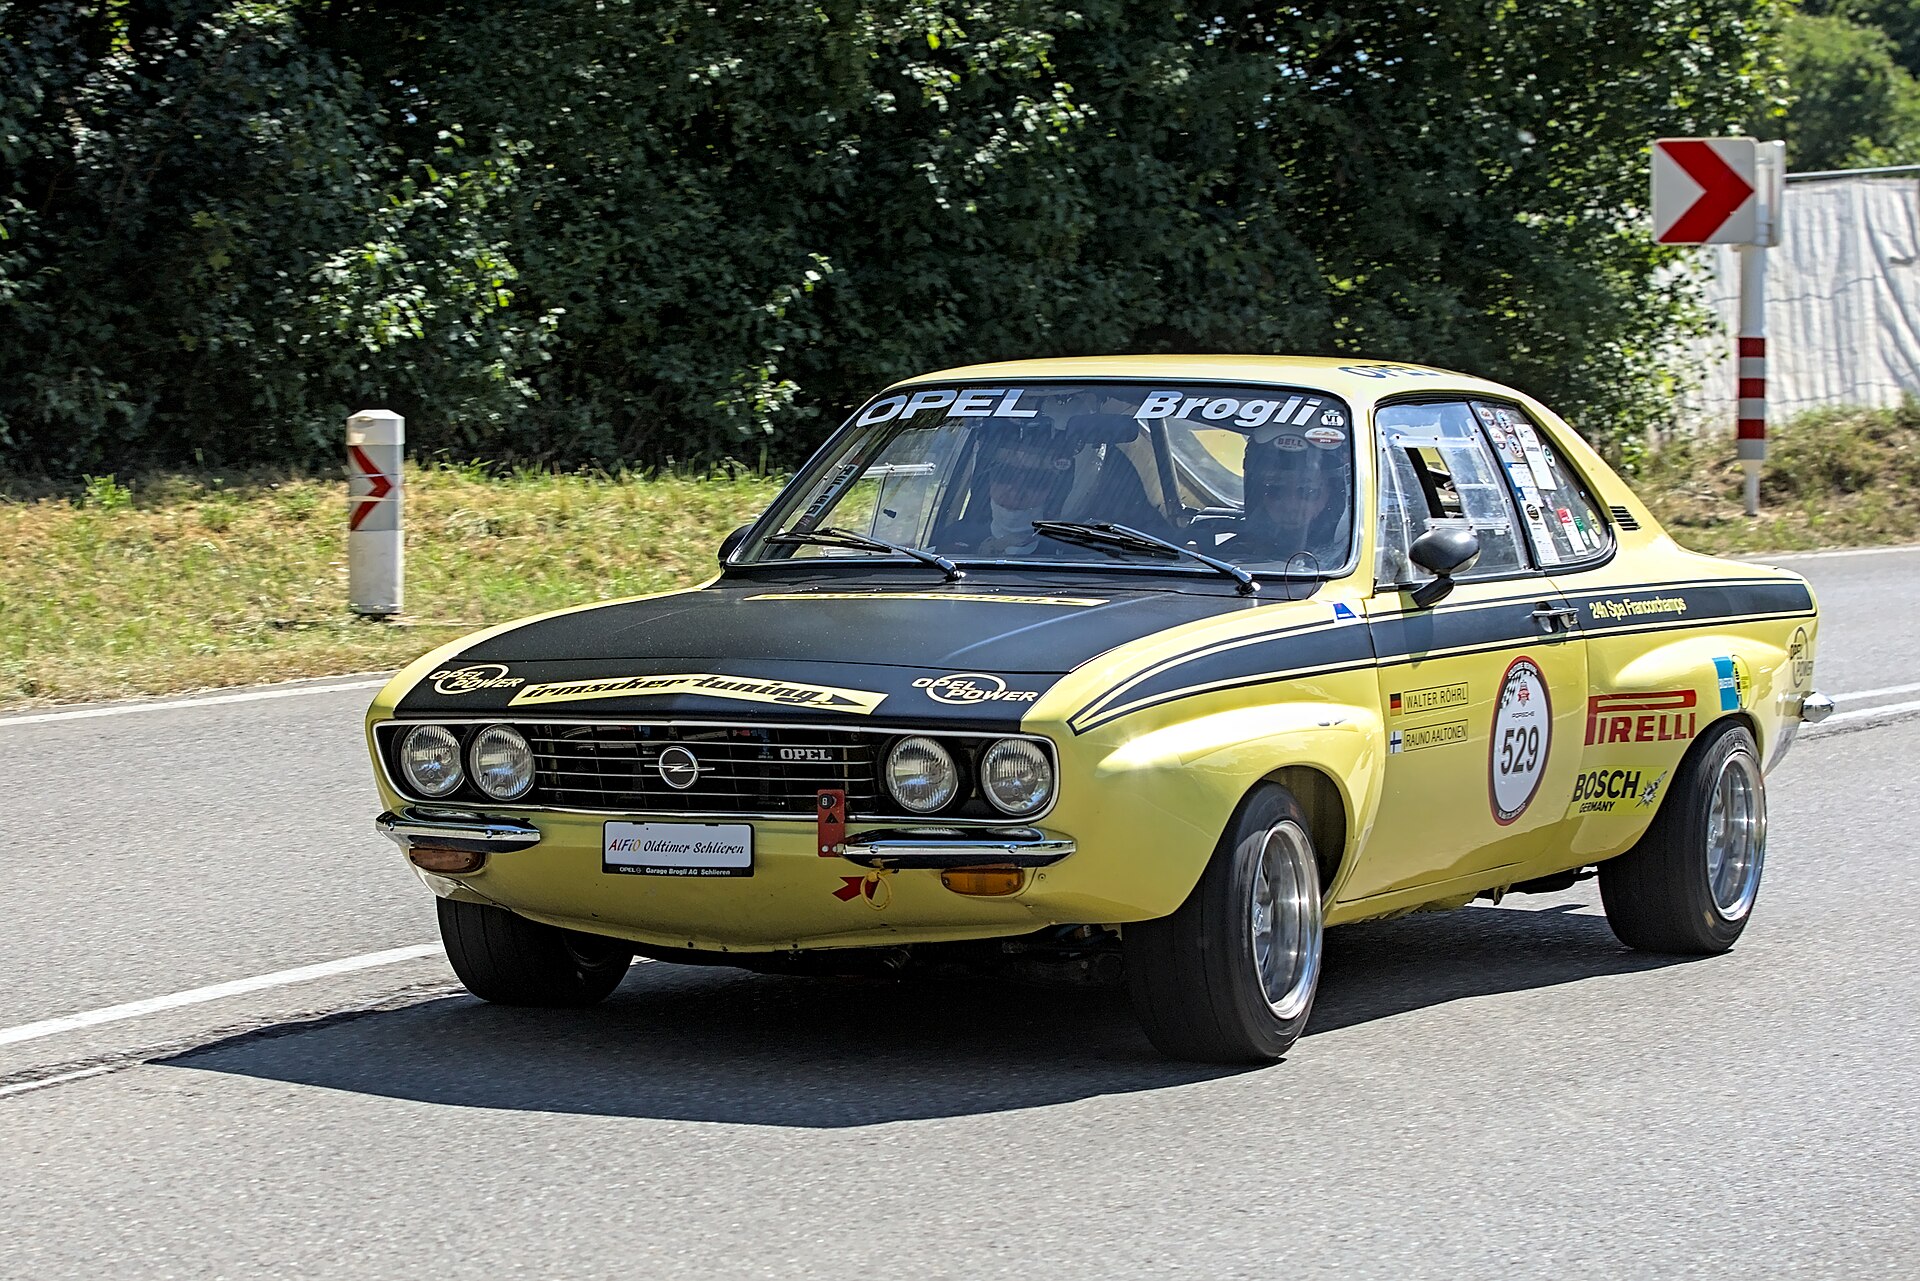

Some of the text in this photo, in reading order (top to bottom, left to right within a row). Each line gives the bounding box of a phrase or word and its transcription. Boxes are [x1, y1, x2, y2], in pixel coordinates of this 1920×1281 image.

[856, 389, 1038, 427] OPEL
[1134, 391, 1322, 427] Brogli
[1278, 439, 1303, 447] BELL
[1589, 596, 1687, 620] 24h Spa Francorchamps
[429, 670, 485, 681] OPEL
[447, 677, 525, 688] POWER
[911, 678, 976, 690] OPEL
[521, 676, 824, 703] irmscher tuning
[944, 689, 1039, 701] POWER
[1406, 687, 1466, 708] WALTER RÖHRL
[1584, 689, 1697, 746] PIRELLI
[1406, 724, 1466, 746] RAUNO AALTONEN
[780, 748, 832, 760] OPEL
[1501, 725, 1538, 775] 529
[1571, 769, 1641, 802] BOSCH
[1579, 801, 1615, 813] GERMANY
[643, 839, 690, 854] Oldtimer
[693, 841, 745, 854] Schlieren
[668, 868, 687, 876] Brogli
